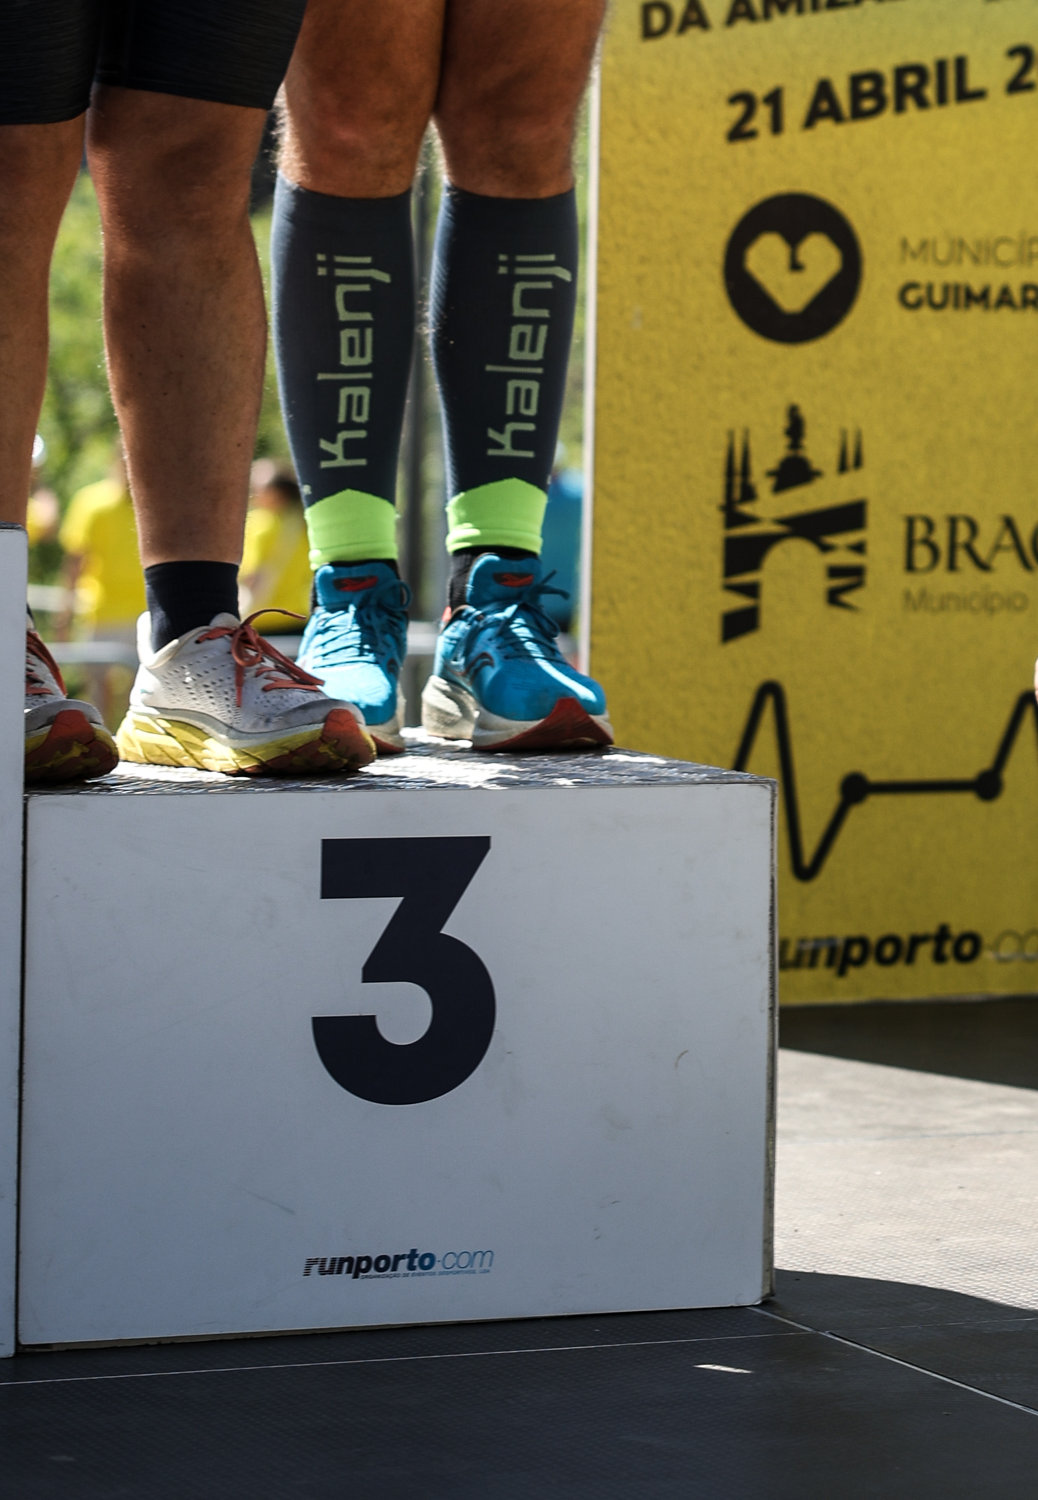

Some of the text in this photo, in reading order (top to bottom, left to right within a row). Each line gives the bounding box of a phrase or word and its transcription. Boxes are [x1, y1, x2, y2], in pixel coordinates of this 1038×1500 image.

[726, 87, 784, 144] 21
[804, 56, 987, 131] ABRIL
[904, 585, 1029, 616] Município
[311, 835, 497, 1106] 3
